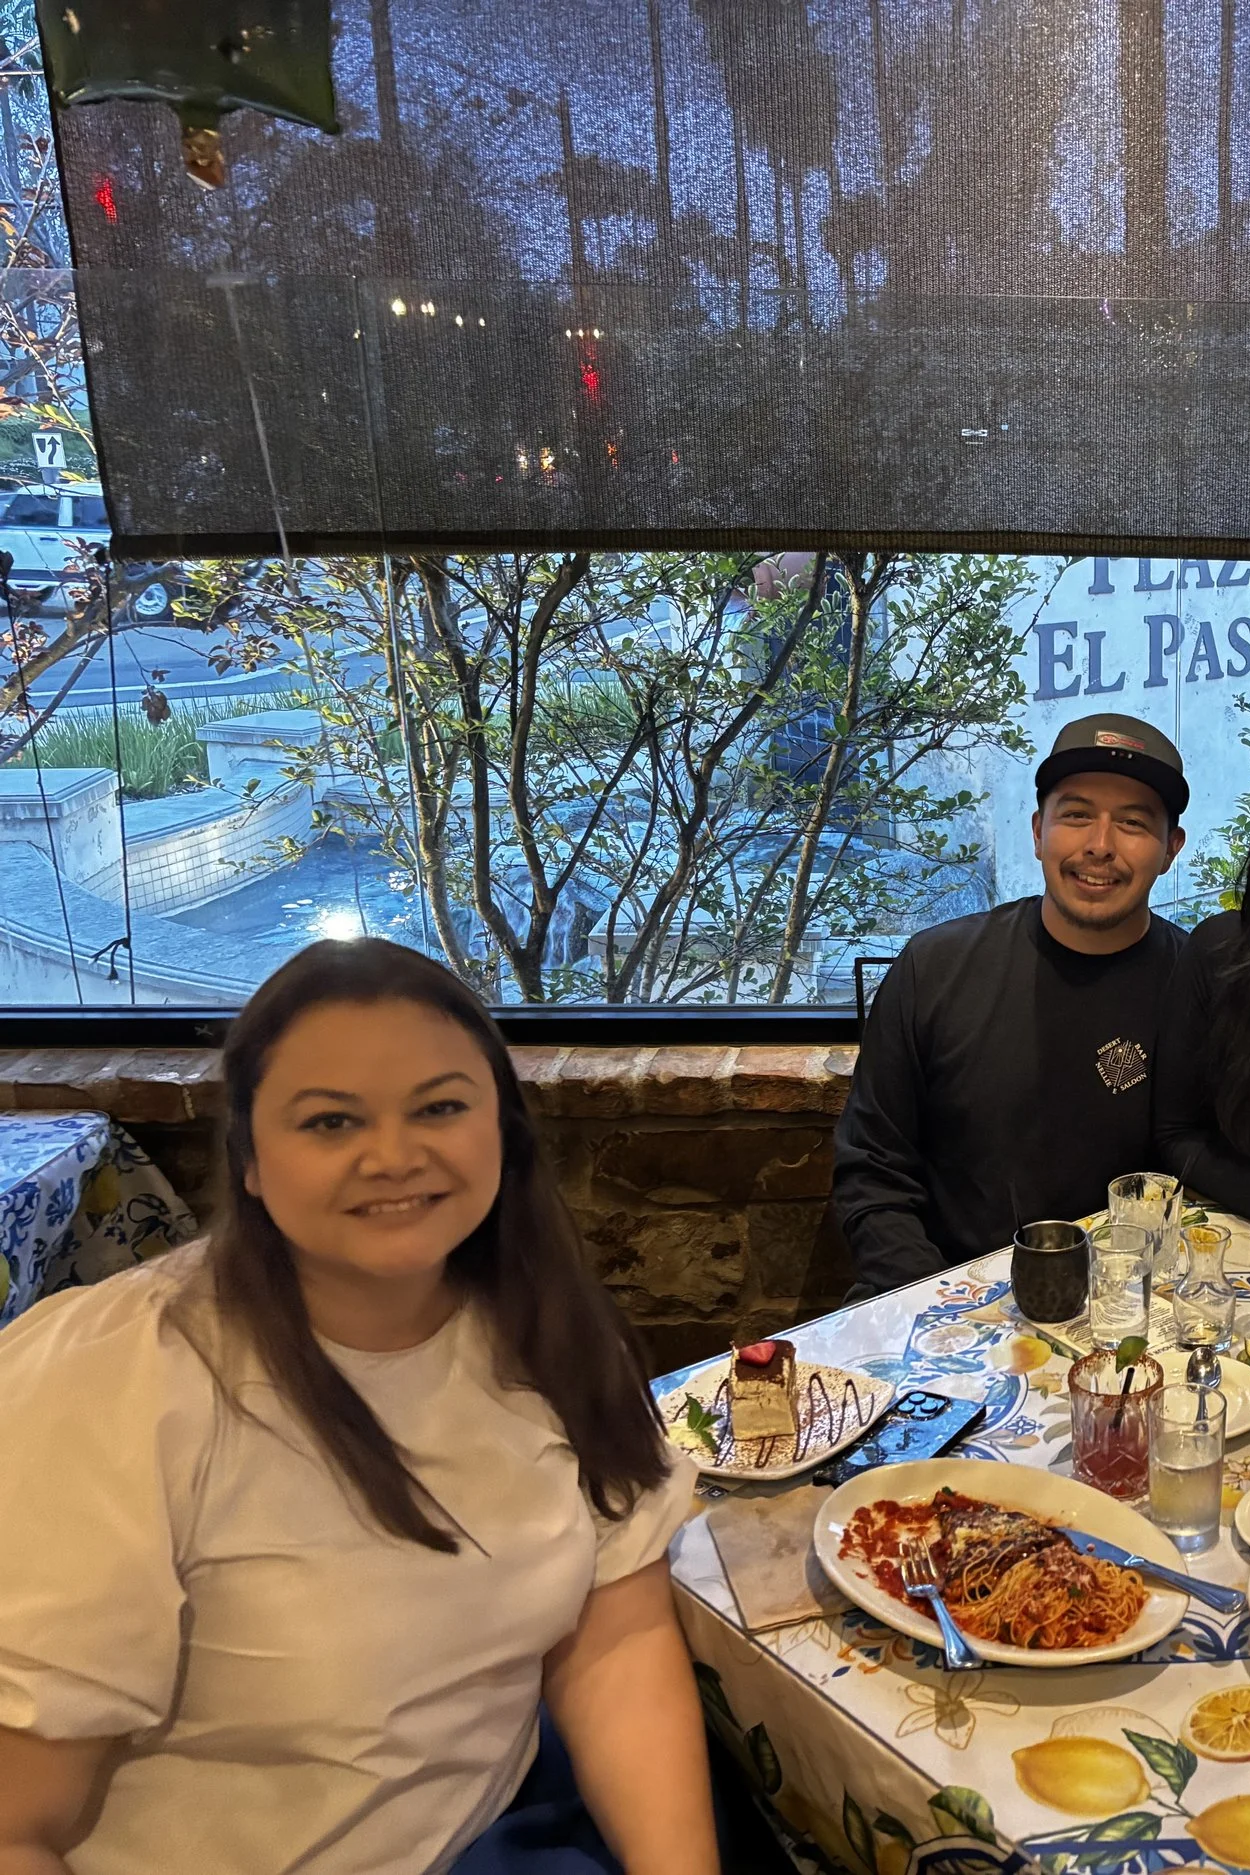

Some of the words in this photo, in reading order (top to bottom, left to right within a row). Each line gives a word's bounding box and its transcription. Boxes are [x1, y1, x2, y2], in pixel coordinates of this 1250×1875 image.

[1033, 621, 1126, 701] EL
[1097, 1037, 1121, 1055] DESERT
[1134, 1043, 1147, 1060] BAR
[1095, 1062, 1112, 1087] NELLIE
[1120, 1072, 1147, 1091] SALOON
